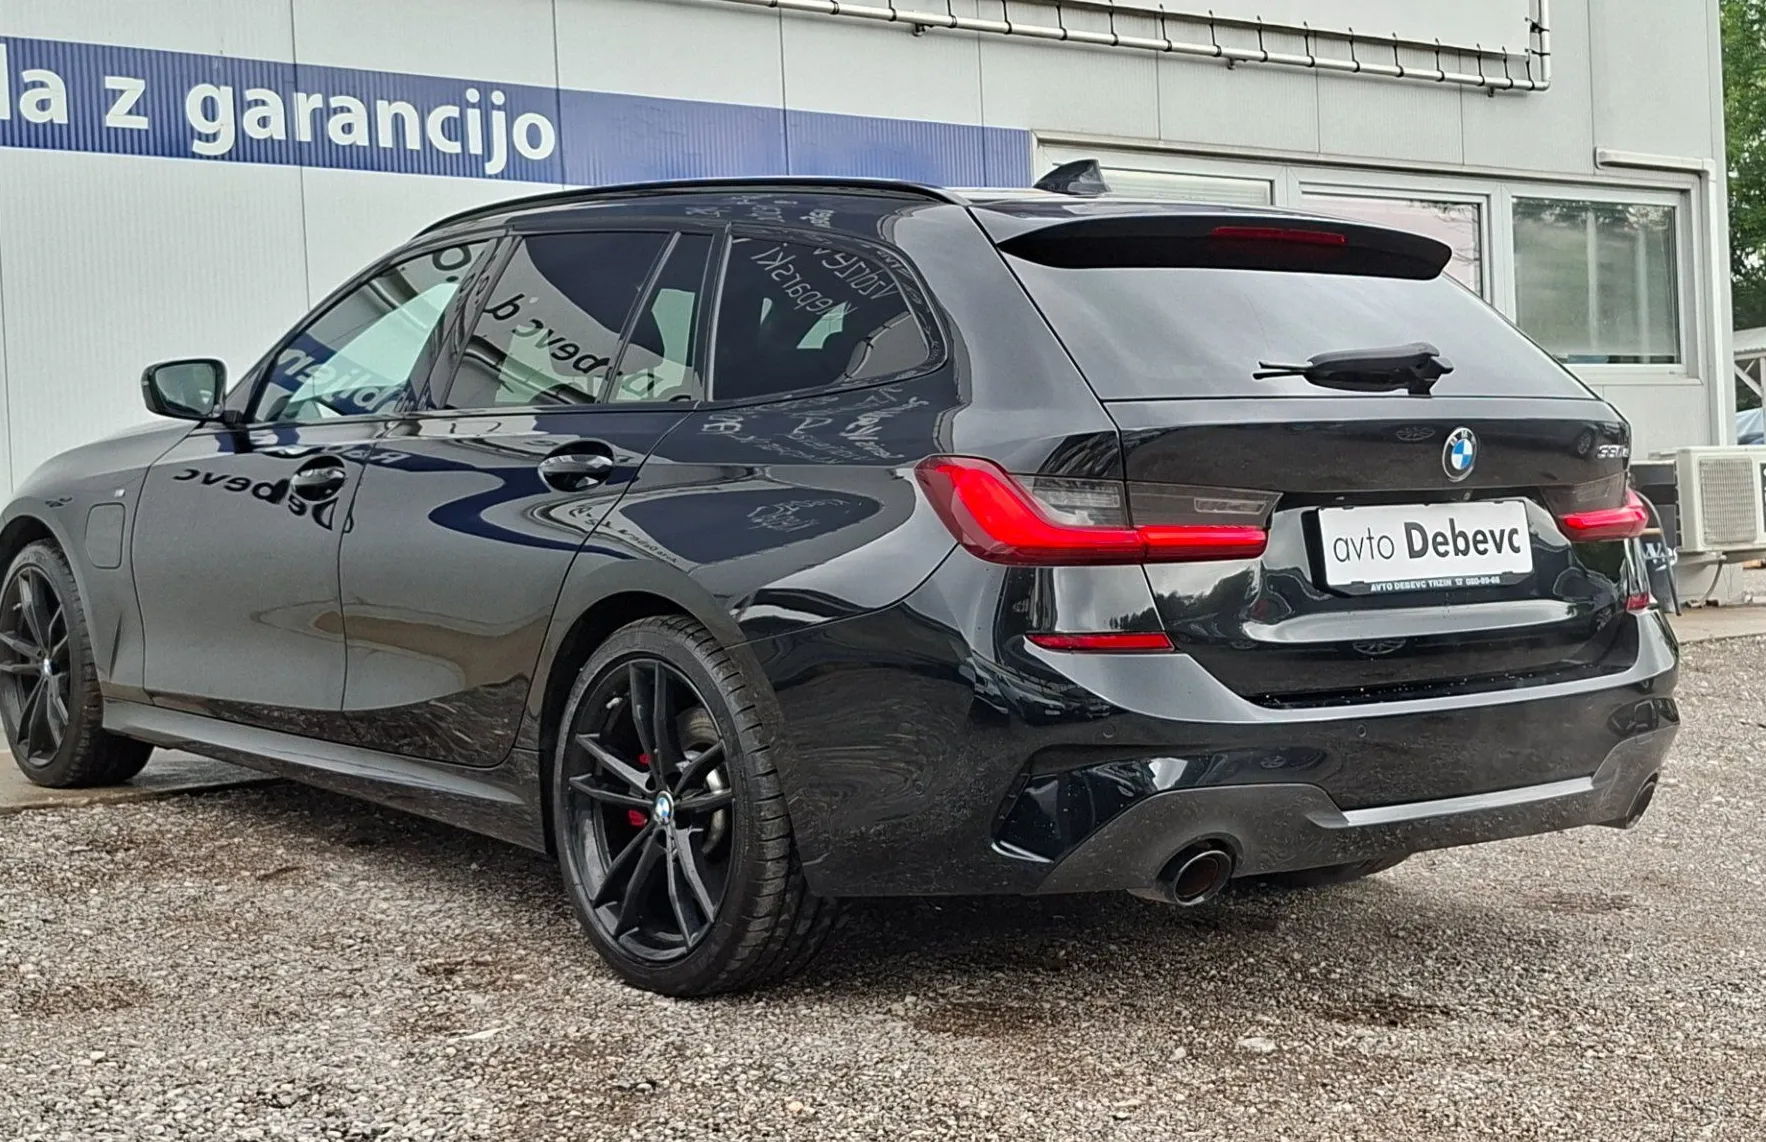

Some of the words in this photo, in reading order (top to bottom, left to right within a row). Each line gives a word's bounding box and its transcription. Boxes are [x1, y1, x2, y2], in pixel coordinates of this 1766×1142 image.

[104, 75, 149, 129] z
[185, 81, 556, 175] garancijo
[1333, 526, 1395, 563] avto
[1404, 517, 1521, 559] Debevc
[1370, 583, 1393, 592] AVTO
[1394, 580, 1427, 591] DEBEVC
[1428, 578, 1452, 588] TRZIN
